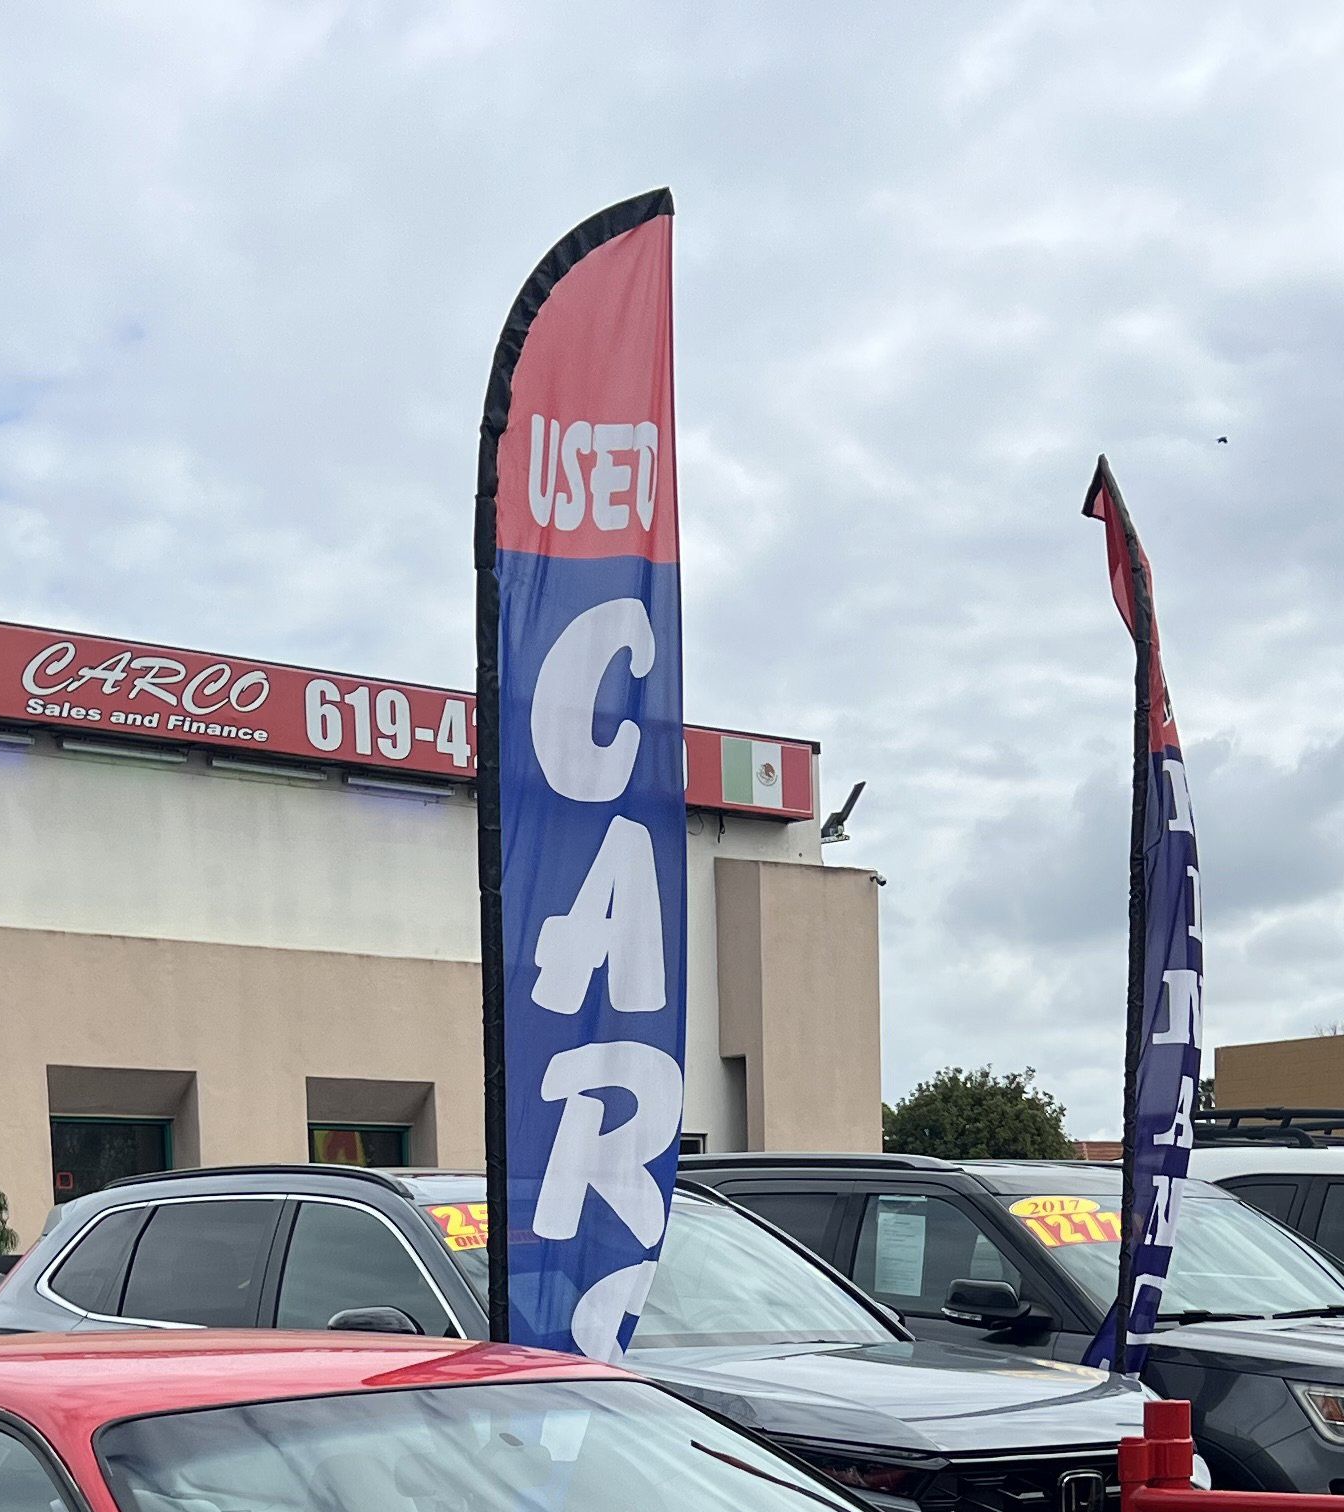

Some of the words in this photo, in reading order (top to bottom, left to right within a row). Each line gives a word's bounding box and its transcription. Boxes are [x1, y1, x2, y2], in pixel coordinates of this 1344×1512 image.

[529, 413, 659, 532] USED
[21, 641, 270, 715] CARCO
[26, 698, 102, 722] Sales
[110, 711, 159, 728] and
[167, 715, 268, 742] Finance
[304, 678, 477, 770] 619-4
[1030, 1199, 1081, 1215] 2017
